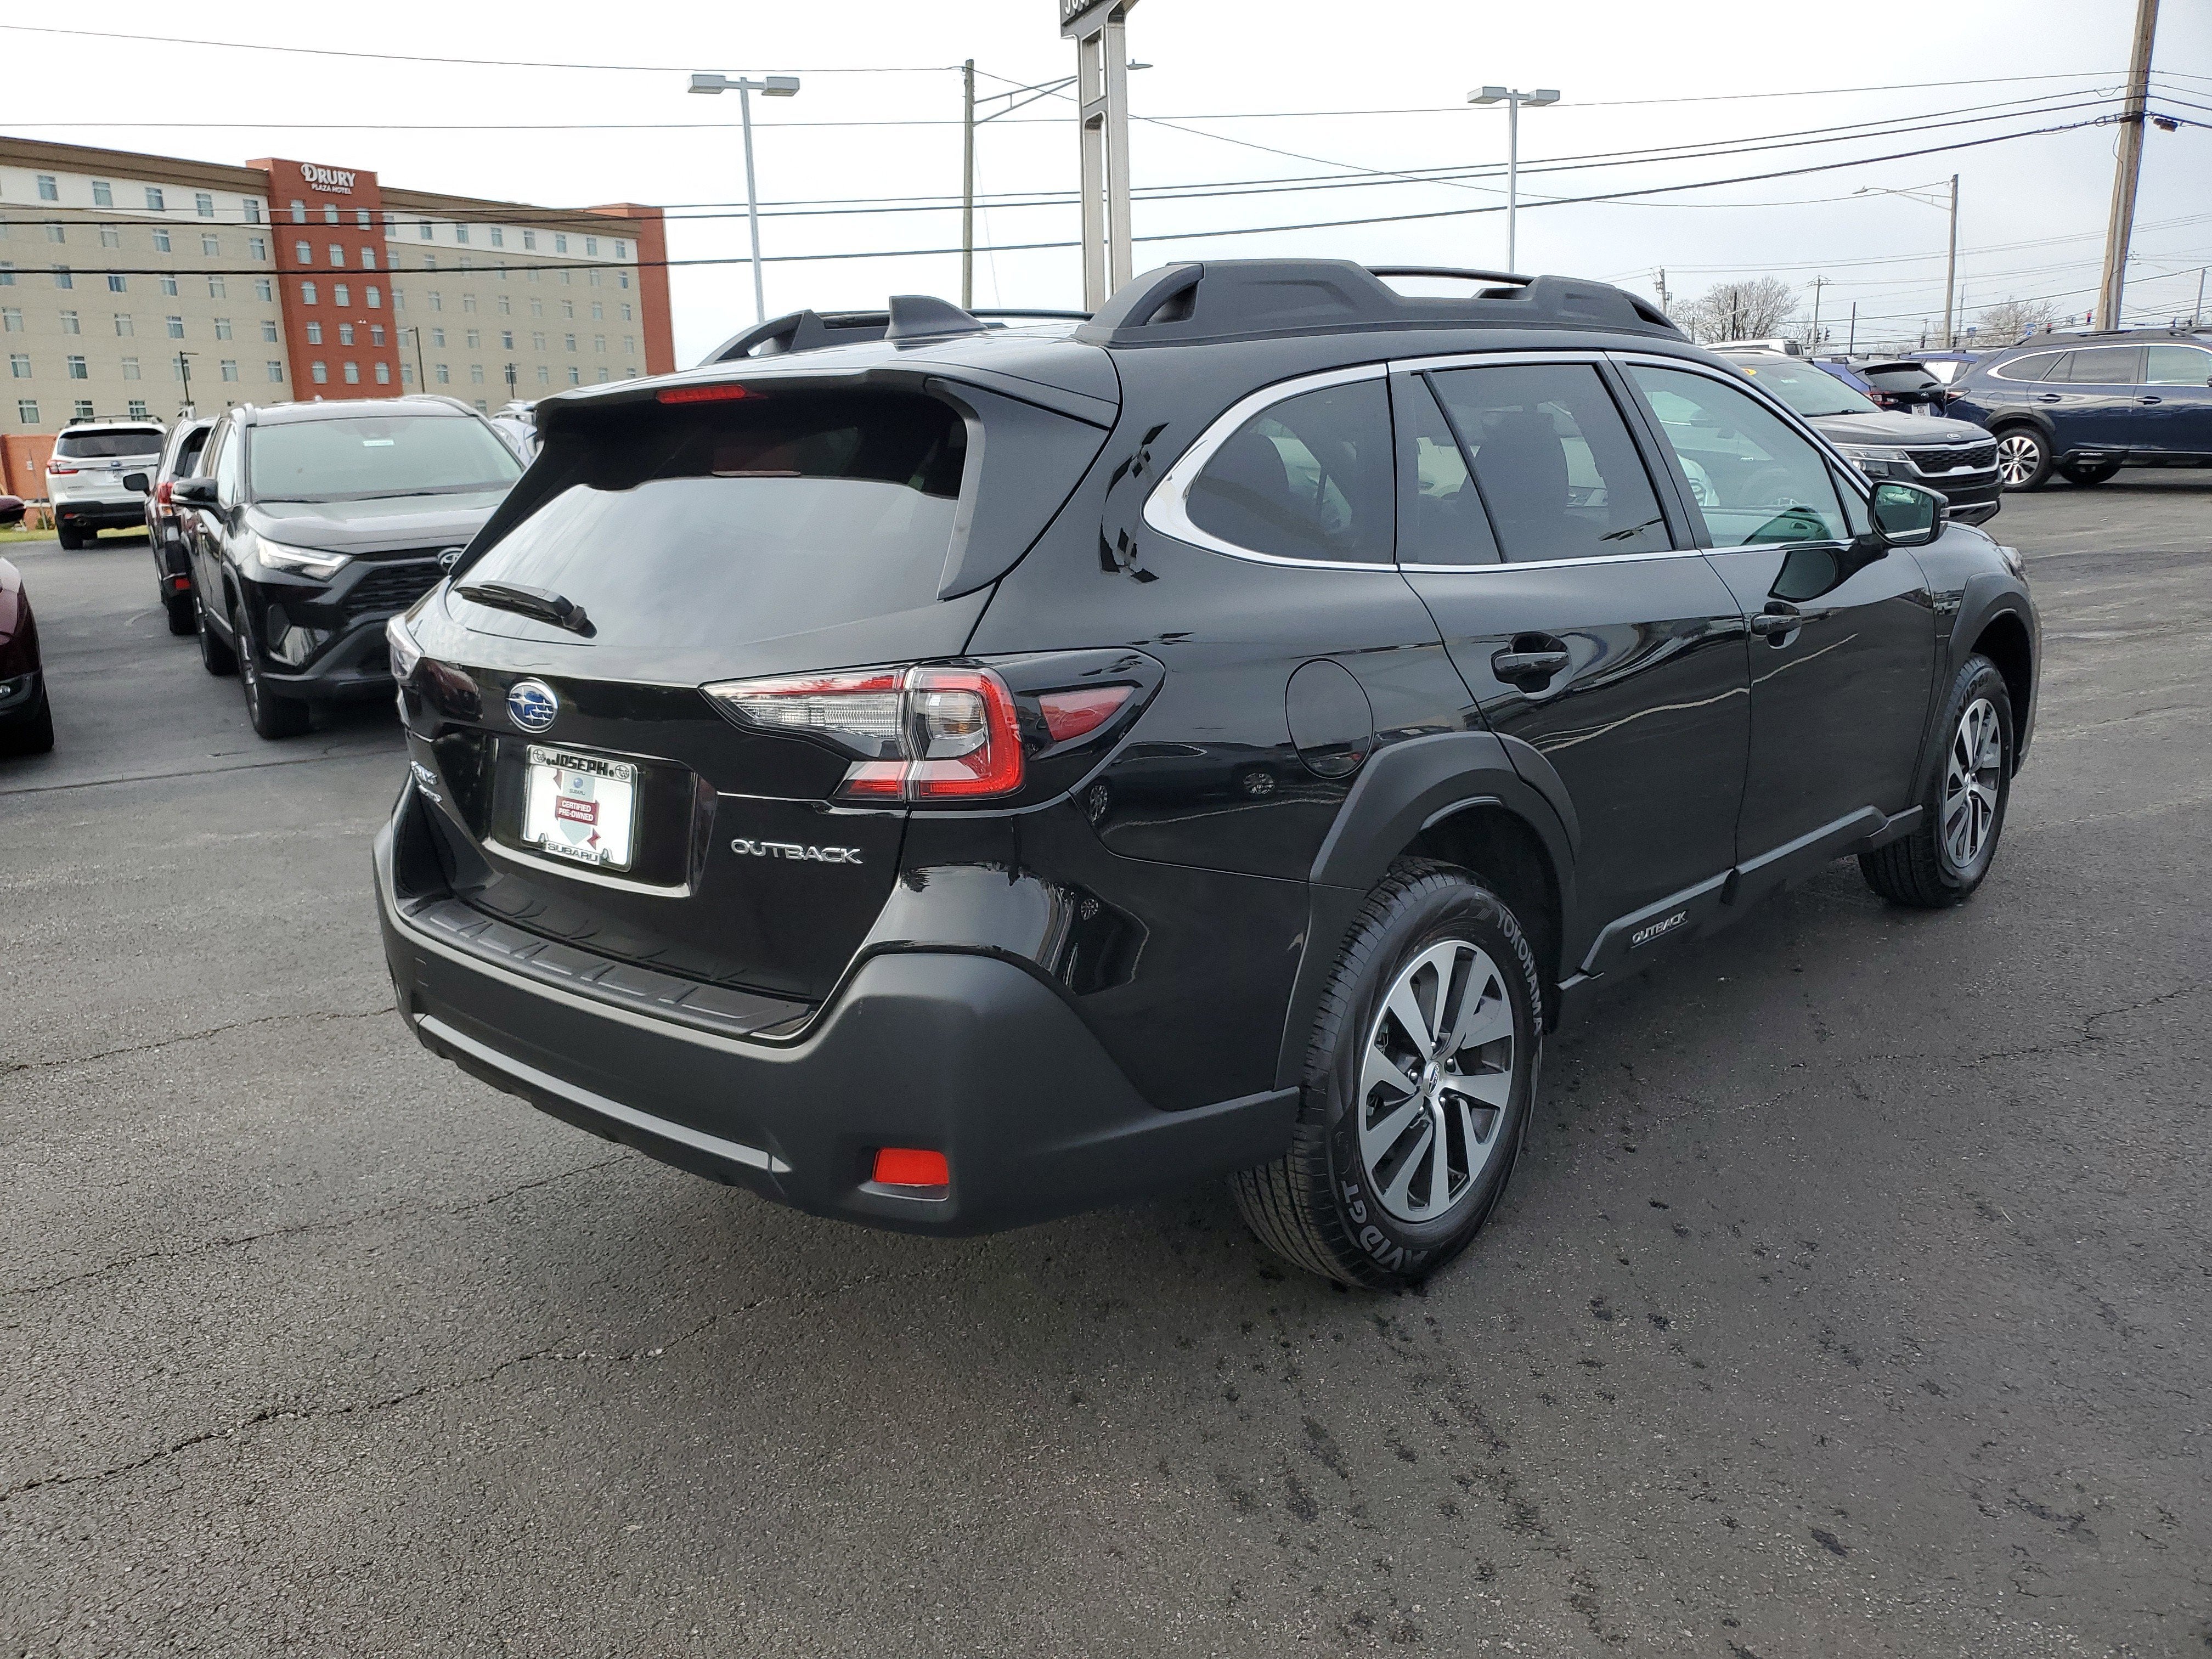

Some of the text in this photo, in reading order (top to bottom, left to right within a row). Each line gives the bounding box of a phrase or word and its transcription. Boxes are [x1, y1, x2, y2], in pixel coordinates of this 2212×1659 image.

[300, 163, 356, 187] DRURY
[311, 183, 352, 195] PLAZA HOTEL
[551, 753, 608, 776] JOSEPH
[558, 808, 594, 821] PRE-OWNED
[562, 800, 591, 812] CERTIFIED
[548, 842, 599, 861] SUBARU
[731, 839, 864, 864] OUTBACK
[1632, 911, 1686, 944] OUTBACK
[1497, 904, 1542, 1036] YOKOHAMA
